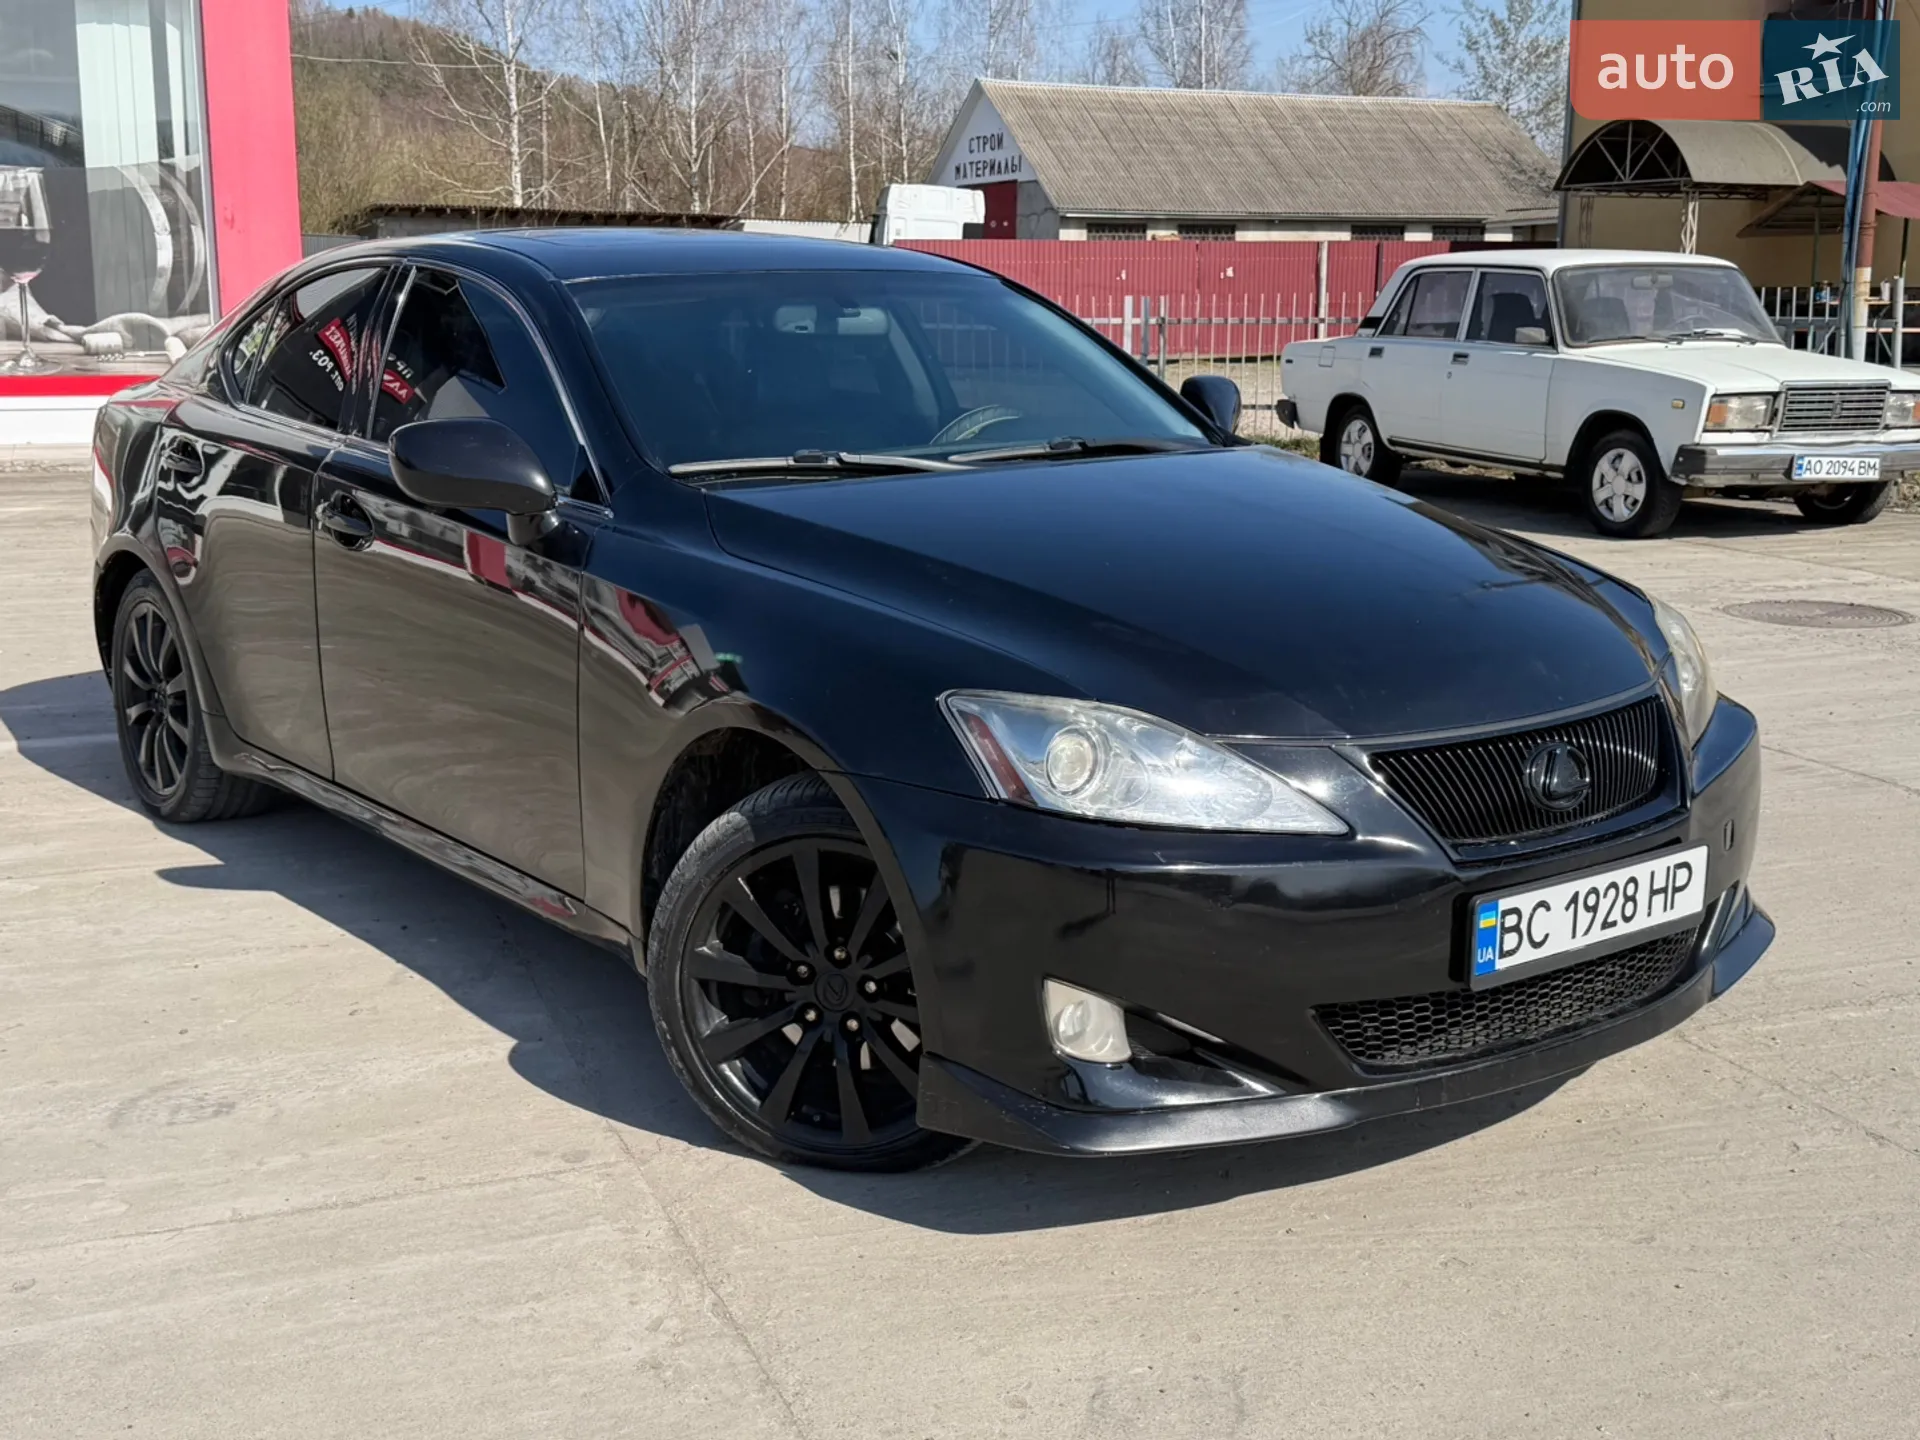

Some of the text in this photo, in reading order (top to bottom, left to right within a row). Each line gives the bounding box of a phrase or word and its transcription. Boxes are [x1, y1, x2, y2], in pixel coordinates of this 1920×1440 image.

[968, 128, 1004, 154] СТРОЙ
[955, 155, 1022, 180] МАТЕРИАЛЫ
[1804, 460, 1878, 476] AO 2094 BM
[1498, 861, 1693, 960] BC 1928 HP
[1477, 949, 1494, 964] UA
